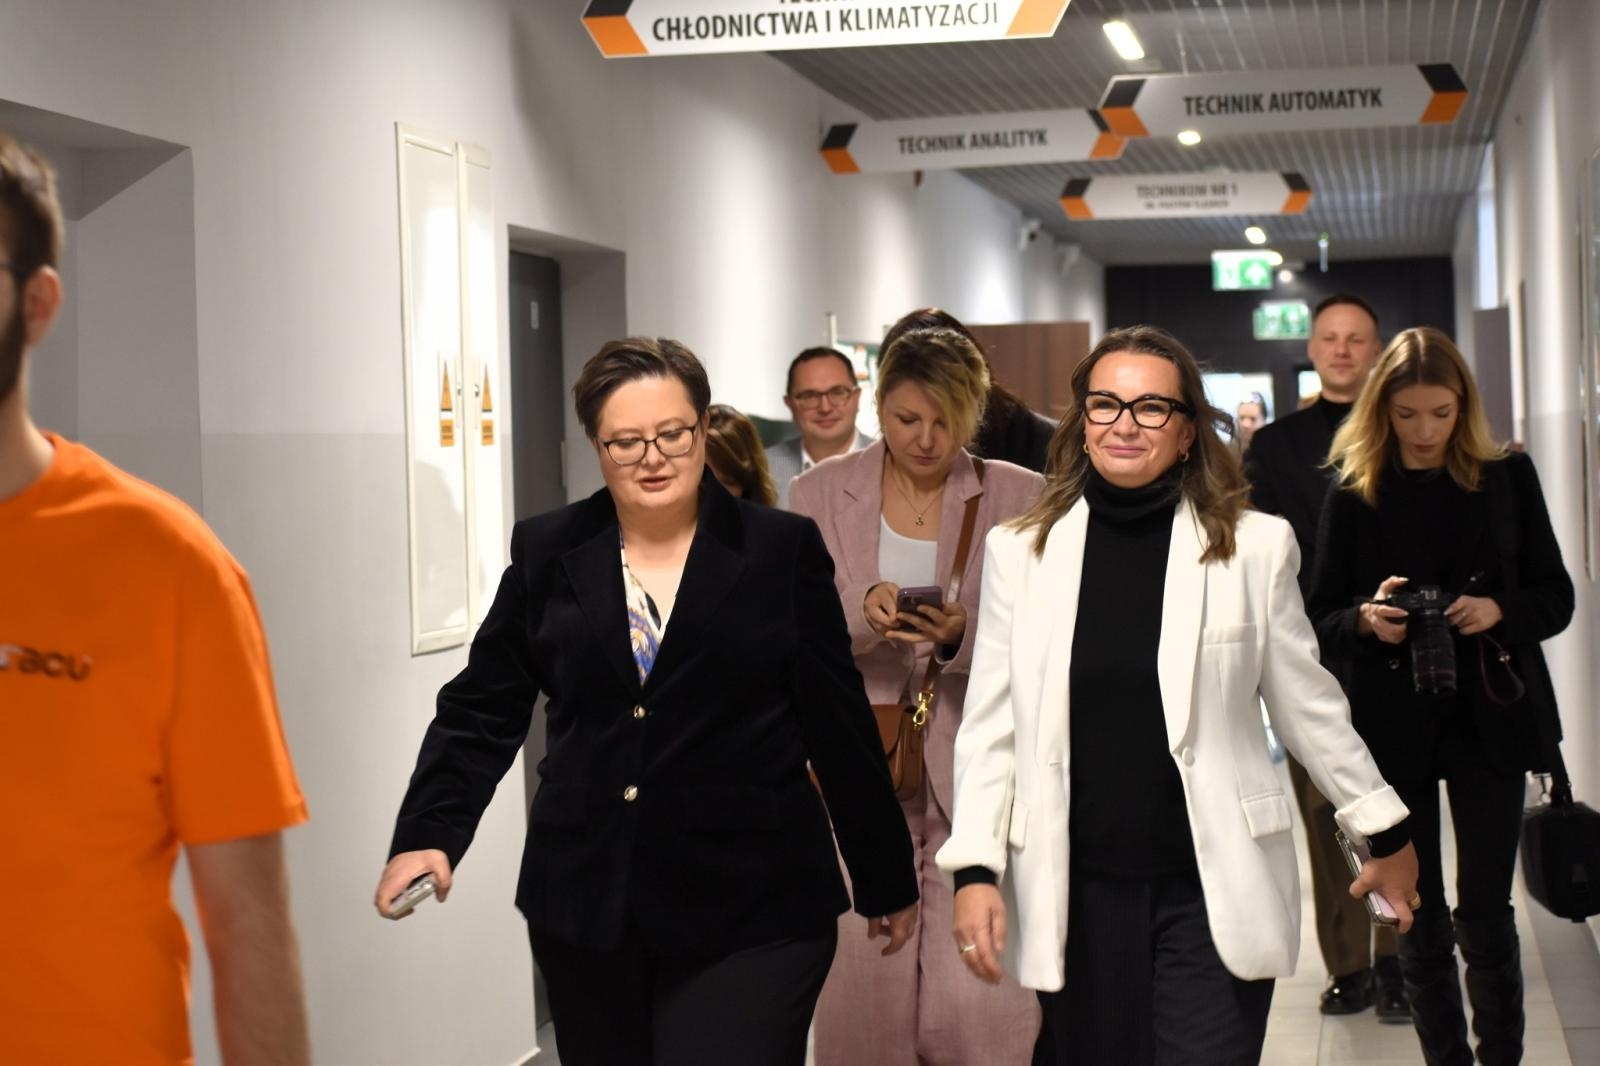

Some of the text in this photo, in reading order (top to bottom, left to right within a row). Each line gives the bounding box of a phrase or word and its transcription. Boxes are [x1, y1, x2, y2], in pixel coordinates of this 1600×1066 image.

[652, 2, 998, 41] CHŁODNICTWA I KLIMATYZACJI
[1184, 88, 1383, 116] TECHNIK AUTOMATYK
[898, 129, 1048, 154] TECHNIK ANALITYK
